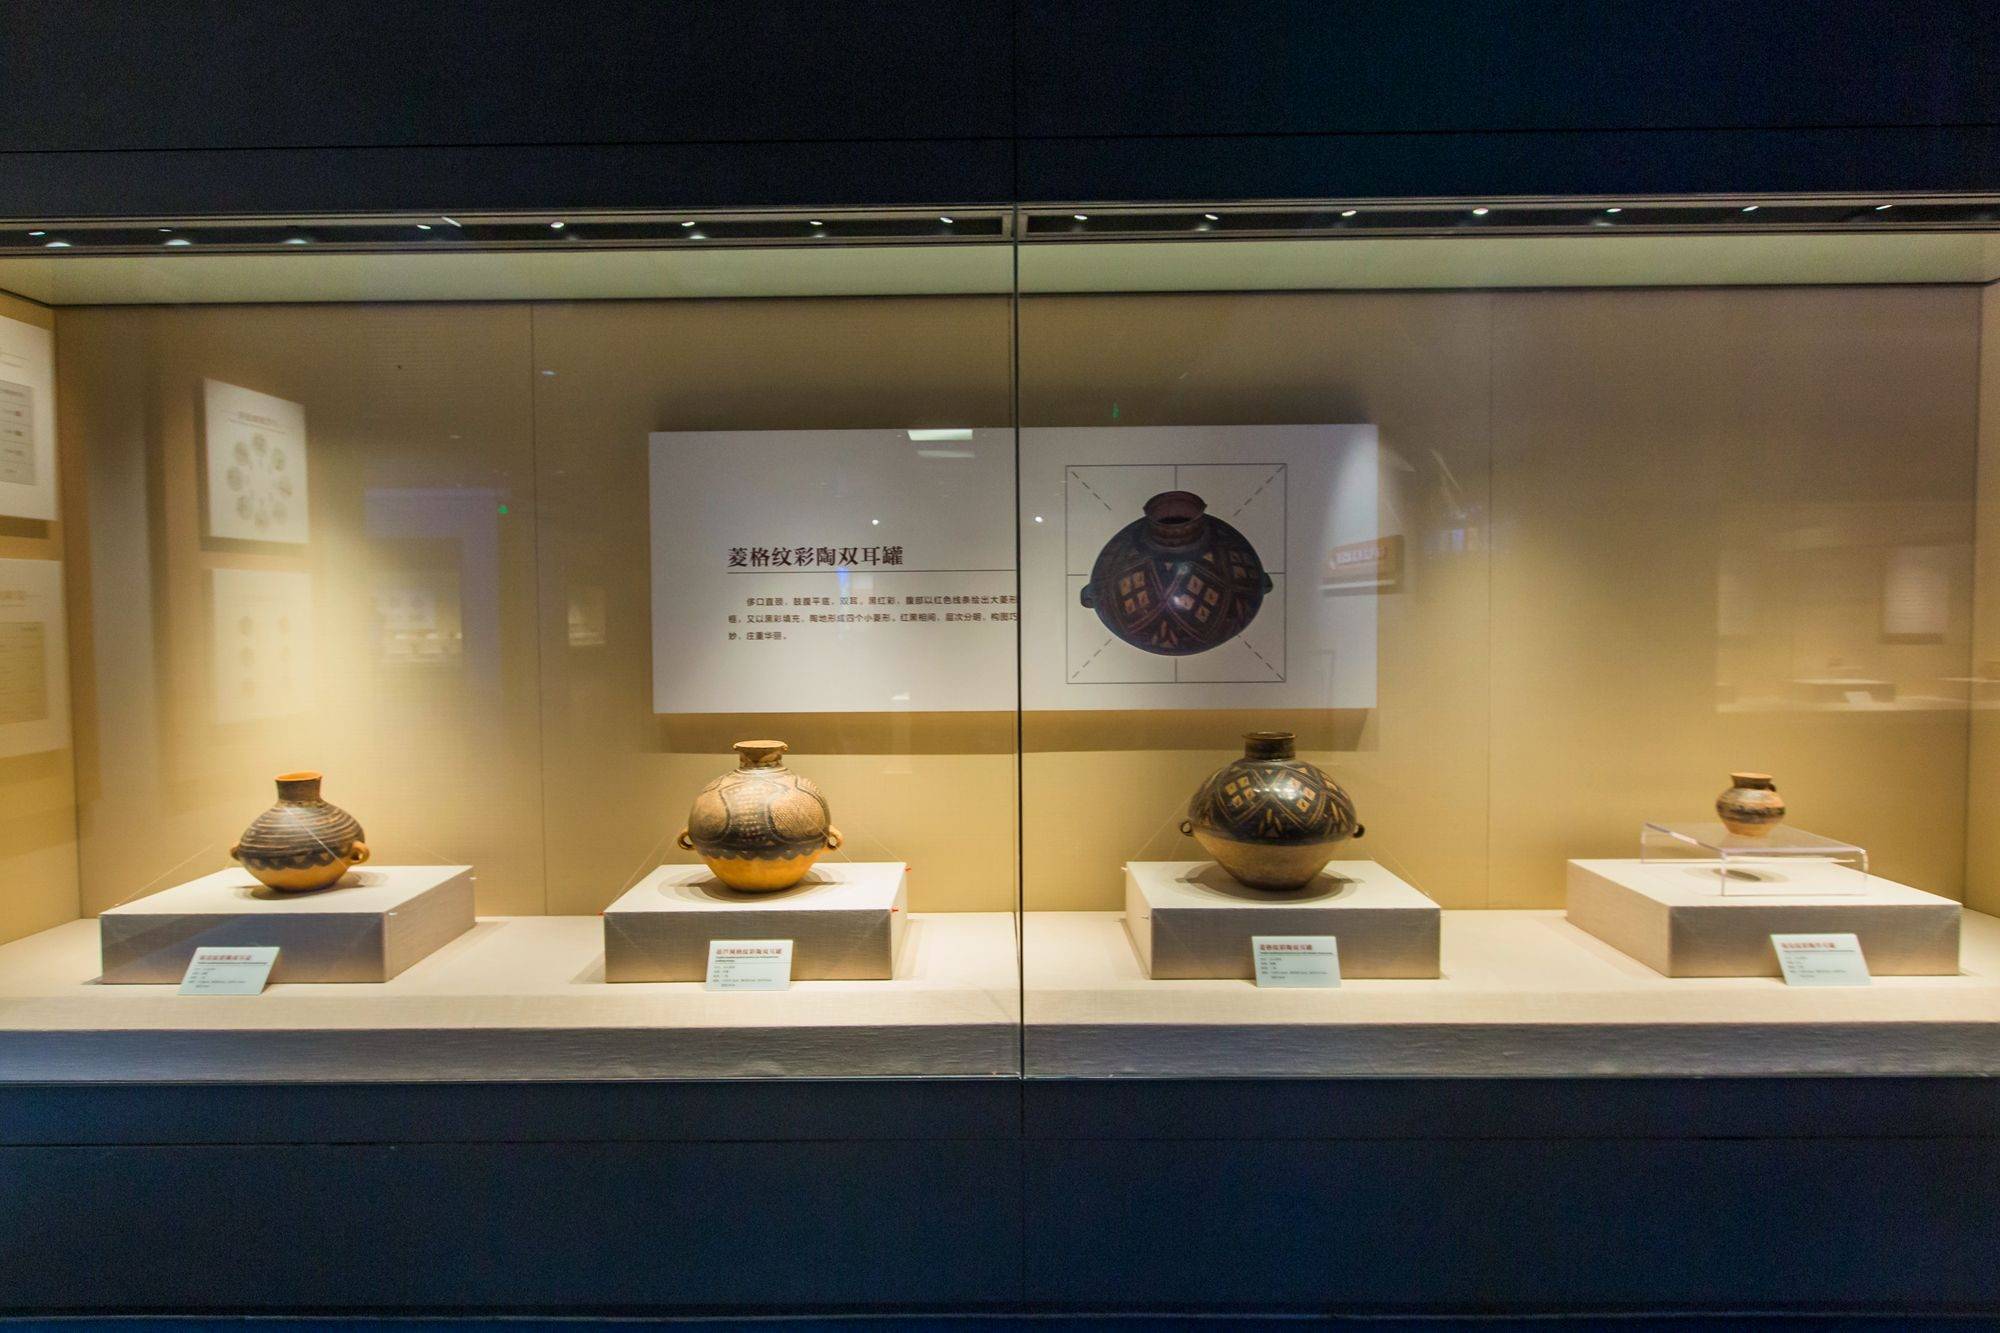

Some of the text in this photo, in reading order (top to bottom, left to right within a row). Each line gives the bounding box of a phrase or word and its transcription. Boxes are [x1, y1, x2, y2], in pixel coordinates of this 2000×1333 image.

[728, 546, 904, 567] 菱格纹彩陶双耳罐
